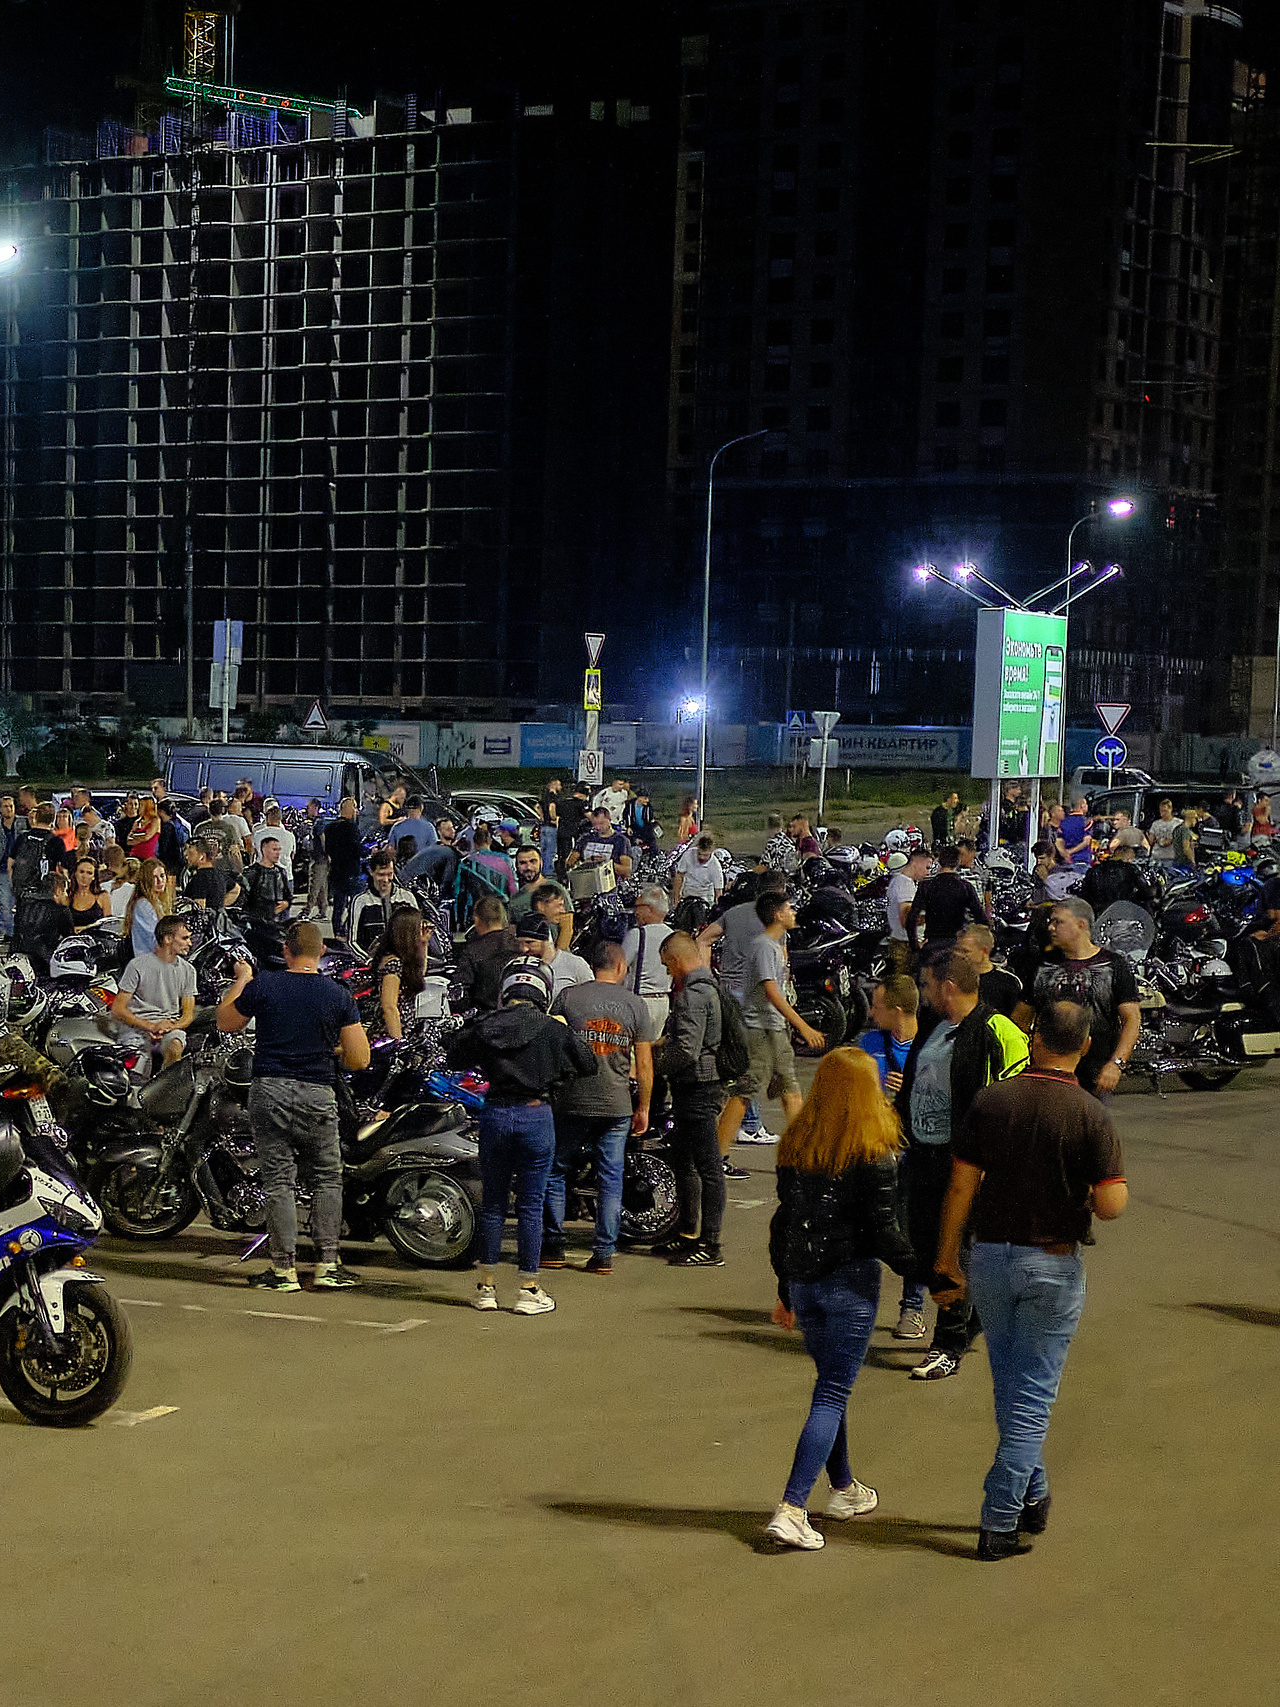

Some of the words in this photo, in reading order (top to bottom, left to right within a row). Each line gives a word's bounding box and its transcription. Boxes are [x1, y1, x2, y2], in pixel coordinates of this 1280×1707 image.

[1005, 636, 1042, 658] Экономьте
[1004, 663, 1029, 686] время!
[867, 738, 938, 750] КВАРТИР
